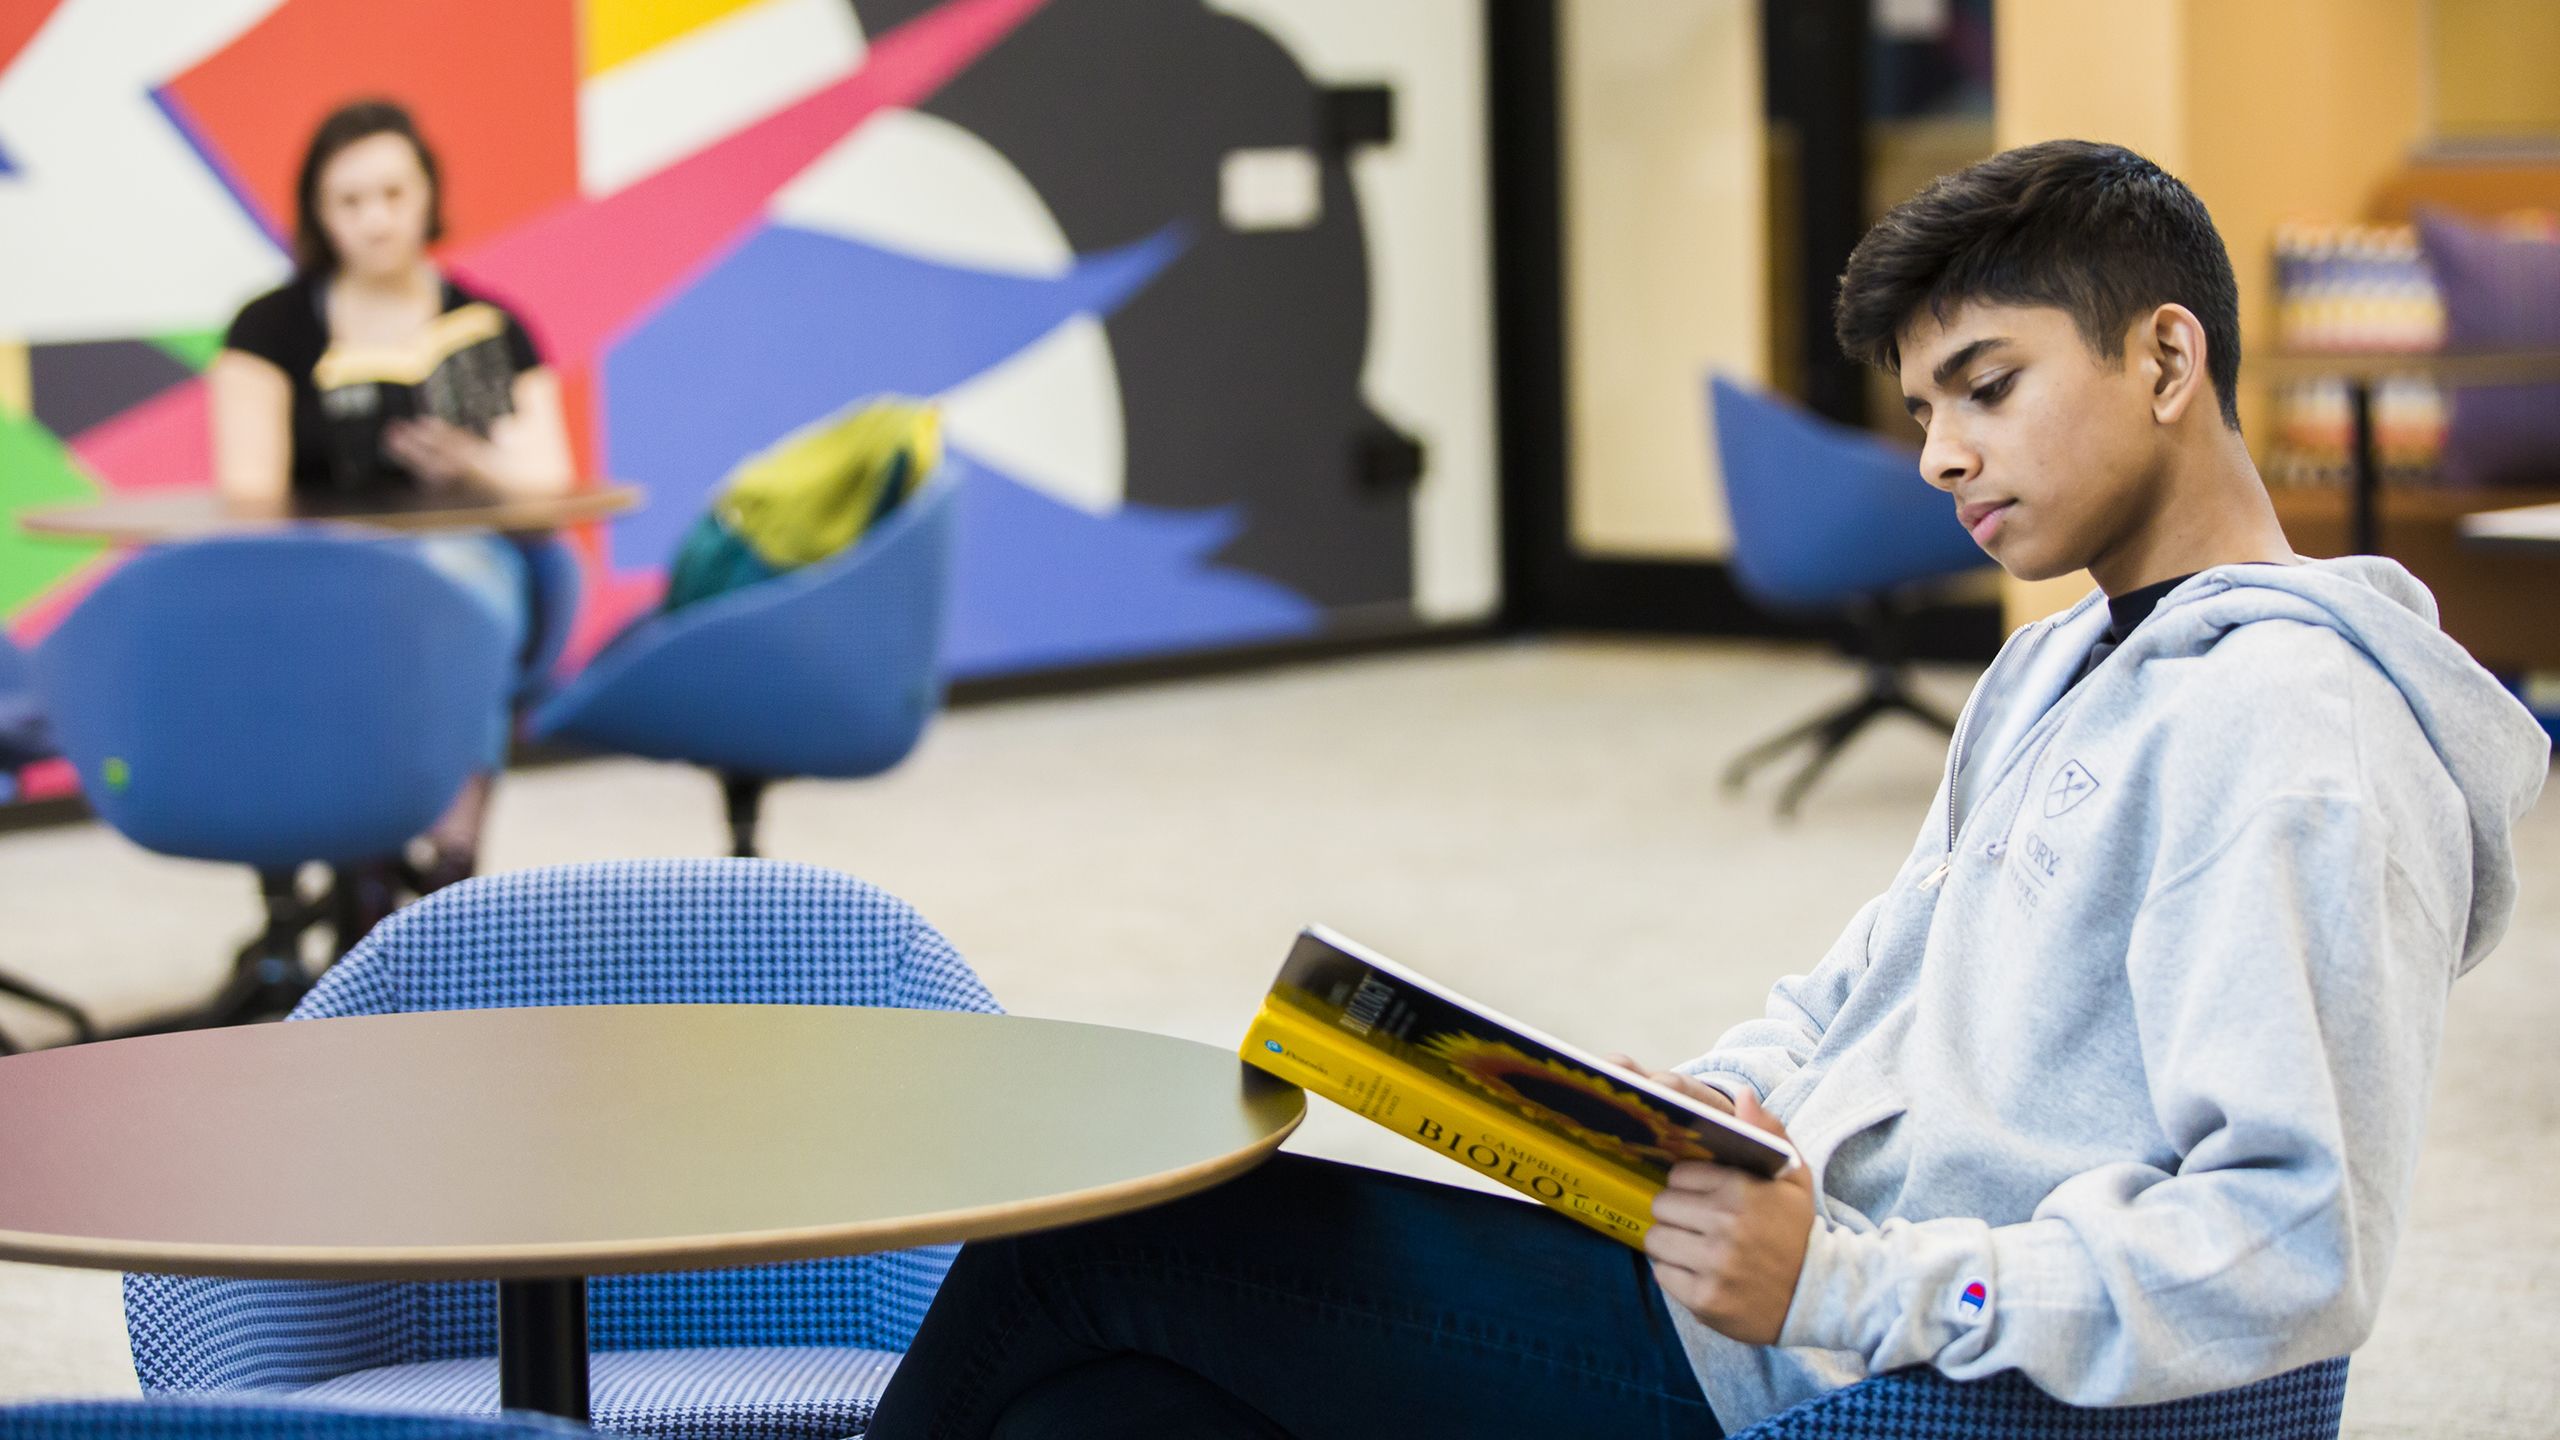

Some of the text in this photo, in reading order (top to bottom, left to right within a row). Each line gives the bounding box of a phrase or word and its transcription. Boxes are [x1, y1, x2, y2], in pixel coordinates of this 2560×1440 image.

[2026, 833, 2061, 876] ORY
[1415, 1116, 1590, 1212] BIOLO
[1481, 1132, 1581, 1188] CAMPBELL
